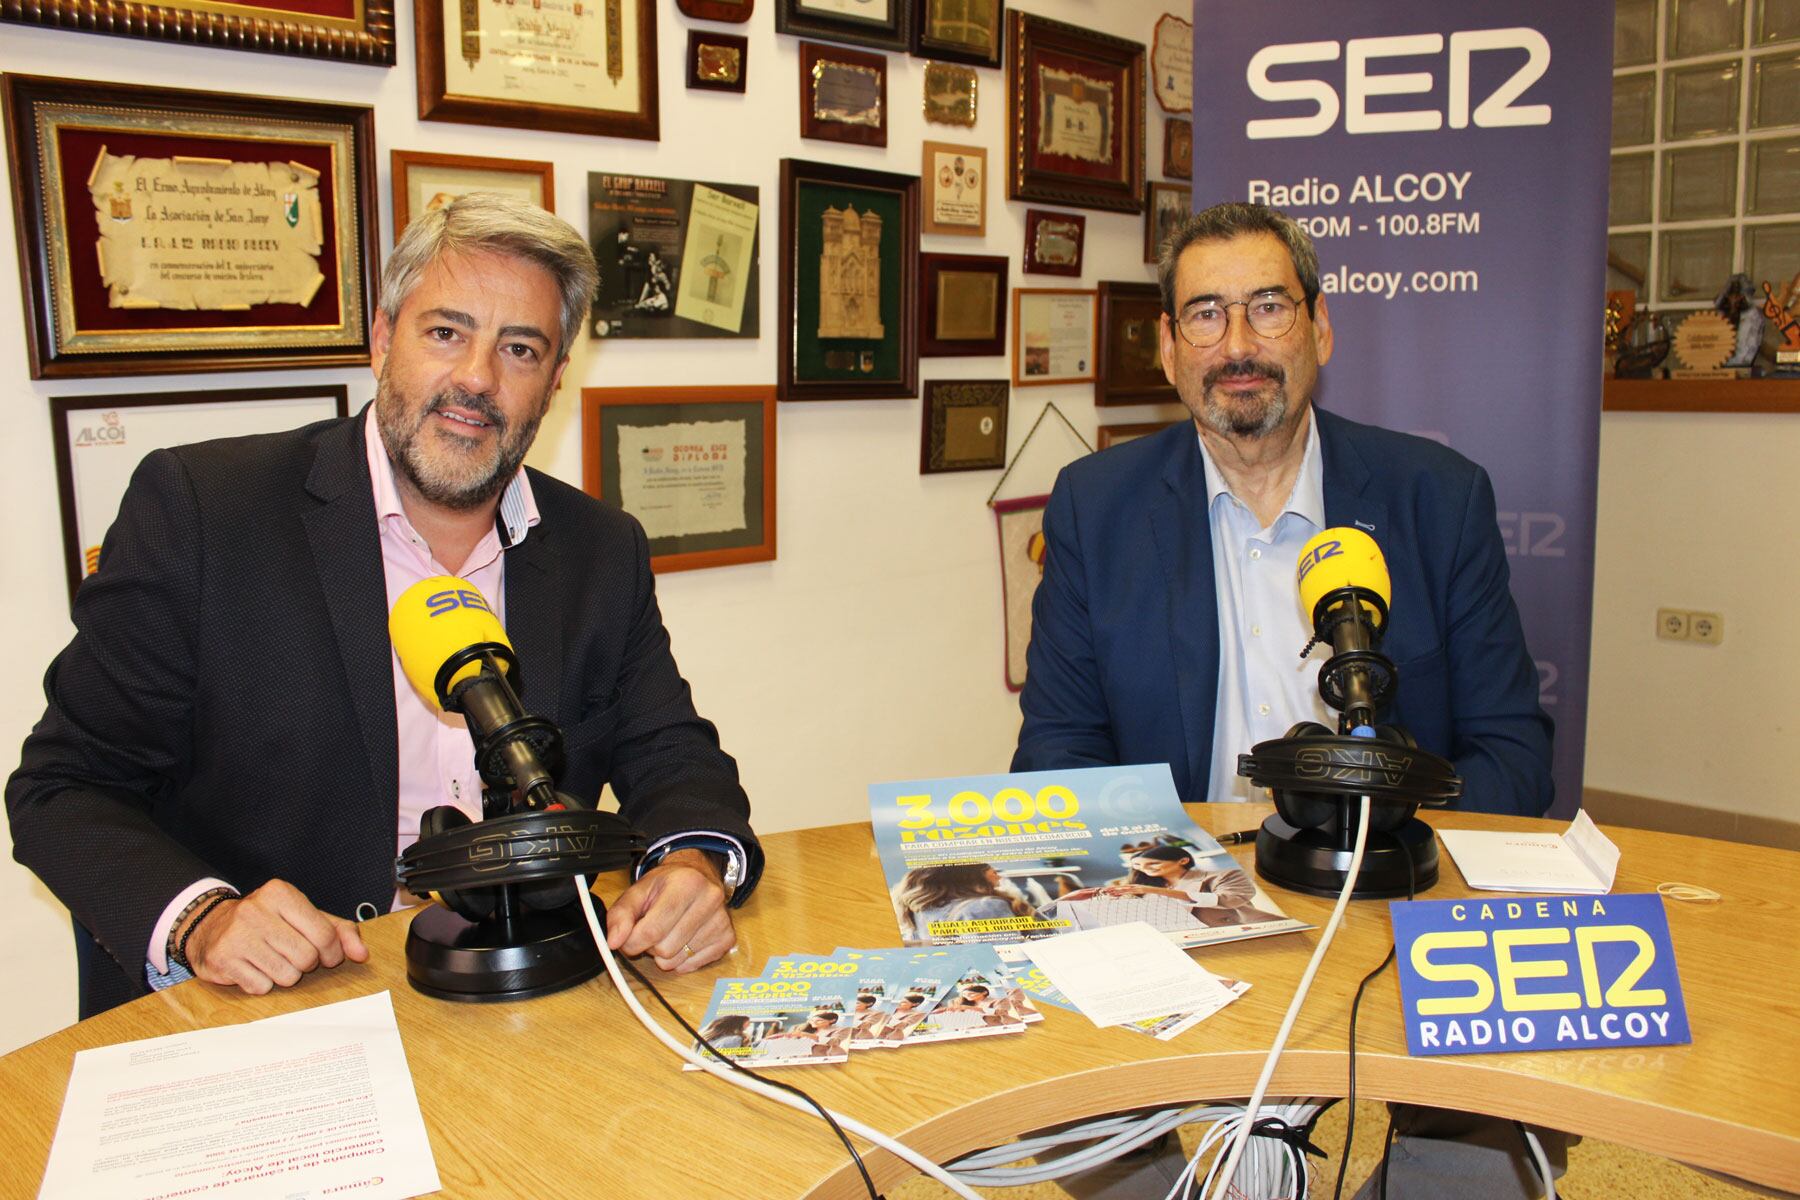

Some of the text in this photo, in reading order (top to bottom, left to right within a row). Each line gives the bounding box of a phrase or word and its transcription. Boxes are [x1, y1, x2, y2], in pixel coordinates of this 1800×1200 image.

[1247, 27, 1552, 139] SER
[1249, 172, 1472, 207] Radio ALCOY
[1376, 212, 1481, 236] 100.8FM
[1319, 266, 1479, 299] alcoy.com
[426, 589, 491, 618] SE
[1295, 748, 1413, 786] AKG
[896, 785, 1080, 829] 3.000
[900, 819, 1088, 843] razones
[932, 839, 977, 848] COMPRAR
[1039, 831, 1088, 841] COMERCIO
[468, 824, 599, 872] AKG
[1451, 899, 1606, 921] CADENA
[930, 917, 1030, 929] REGALO ASEGURADO
[931, 927, 960, 935] PARA
[961, 926, 982, 934] LOS
[1015, 920, 1068, 931] PRIMEROS
[775, 961, 859, 974] 3.000
[1410, 924, 1667, 1016] SER
[726, 981, 812, 994] 3.000
[1420, 1011, 1670, 1048] RADIO ALCOY
[322, 1138, 384, 1155] comercio
[323, 1147, 385, 1163] Campaña
[267, 1159, 285, 1168] de
[288, 1152, 319, 1164] local
[304, 1160, 320, 1168] de
[213, 1180, 230, 1188] de
[234, 1168, 284, 1183] cámara
